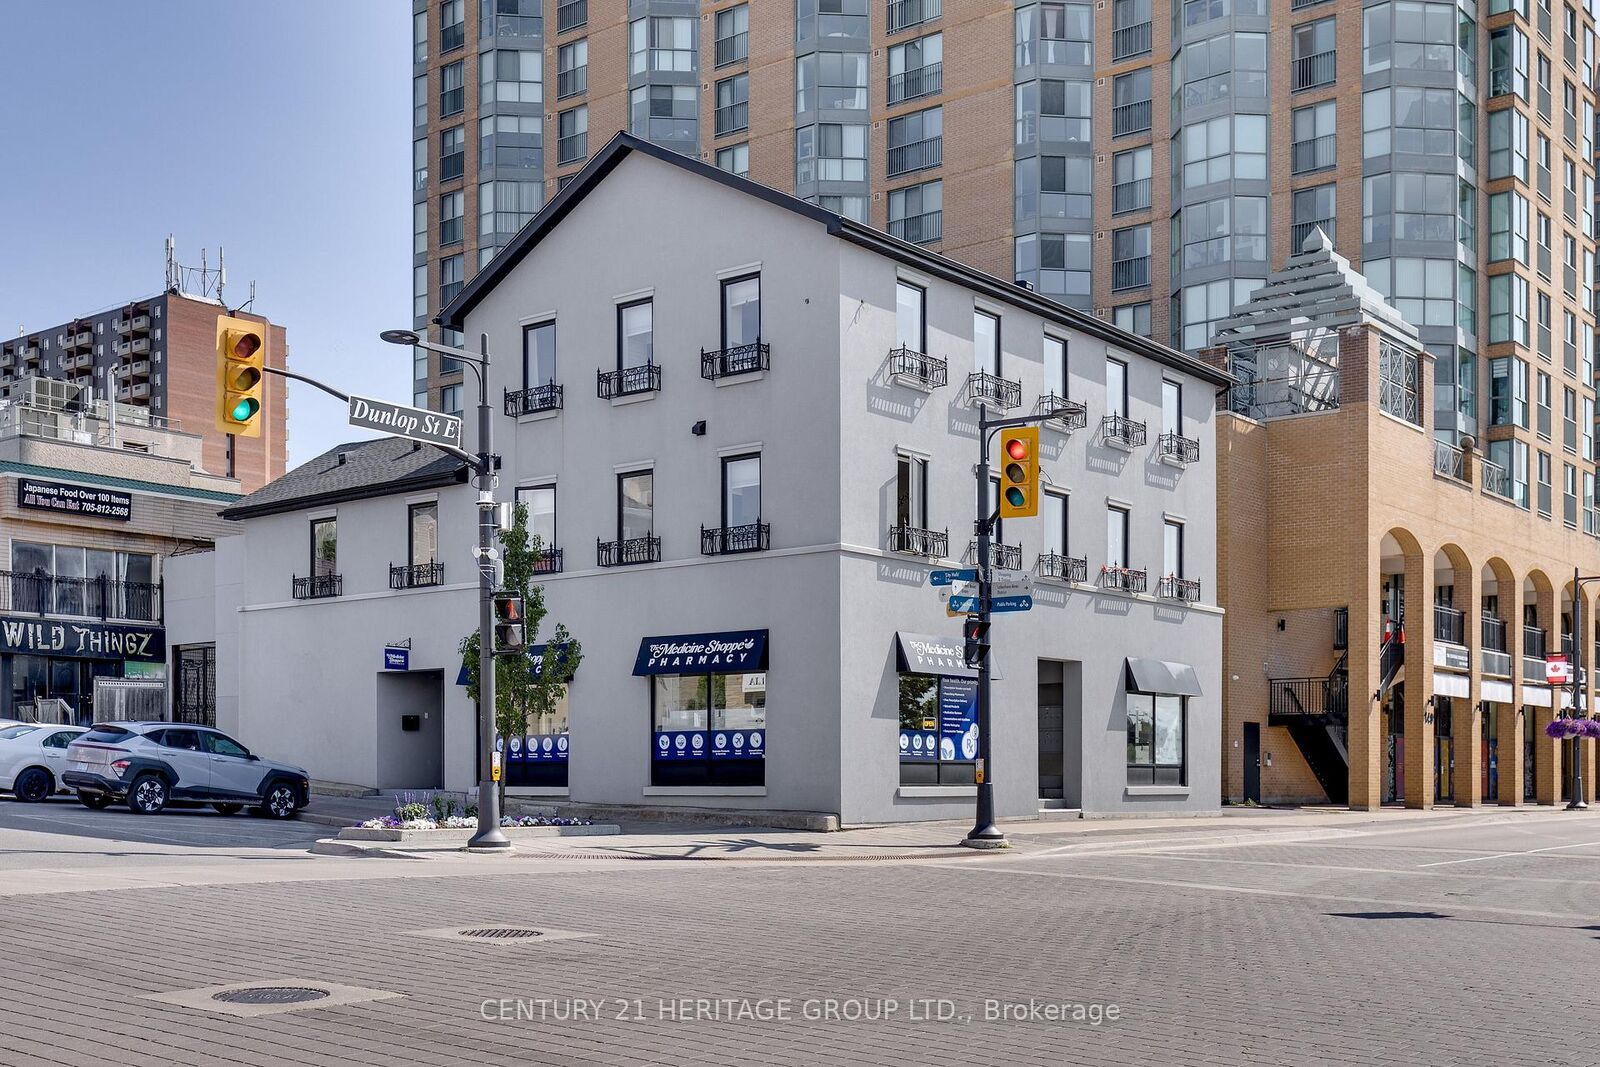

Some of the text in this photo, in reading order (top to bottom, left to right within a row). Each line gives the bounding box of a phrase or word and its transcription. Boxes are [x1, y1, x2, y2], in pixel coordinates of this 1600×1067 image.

[352, 399, 458, 439] Dunlop St E
[23, 483, 130, 505] Japanese Food Over 100 Items
[24, 493, 129, 516] All You Can Eat 705-812-2568
[2, 620, 153, 657] WILD THINGZ
[653, 642, 705, 658] Medicine
[705, 640, 744, 654] Shoppe
[916, 642, 955, 656] Medicine
[647, 653, 748, 667] PHARMACY
[917, 655, 967, 668] PHARM
